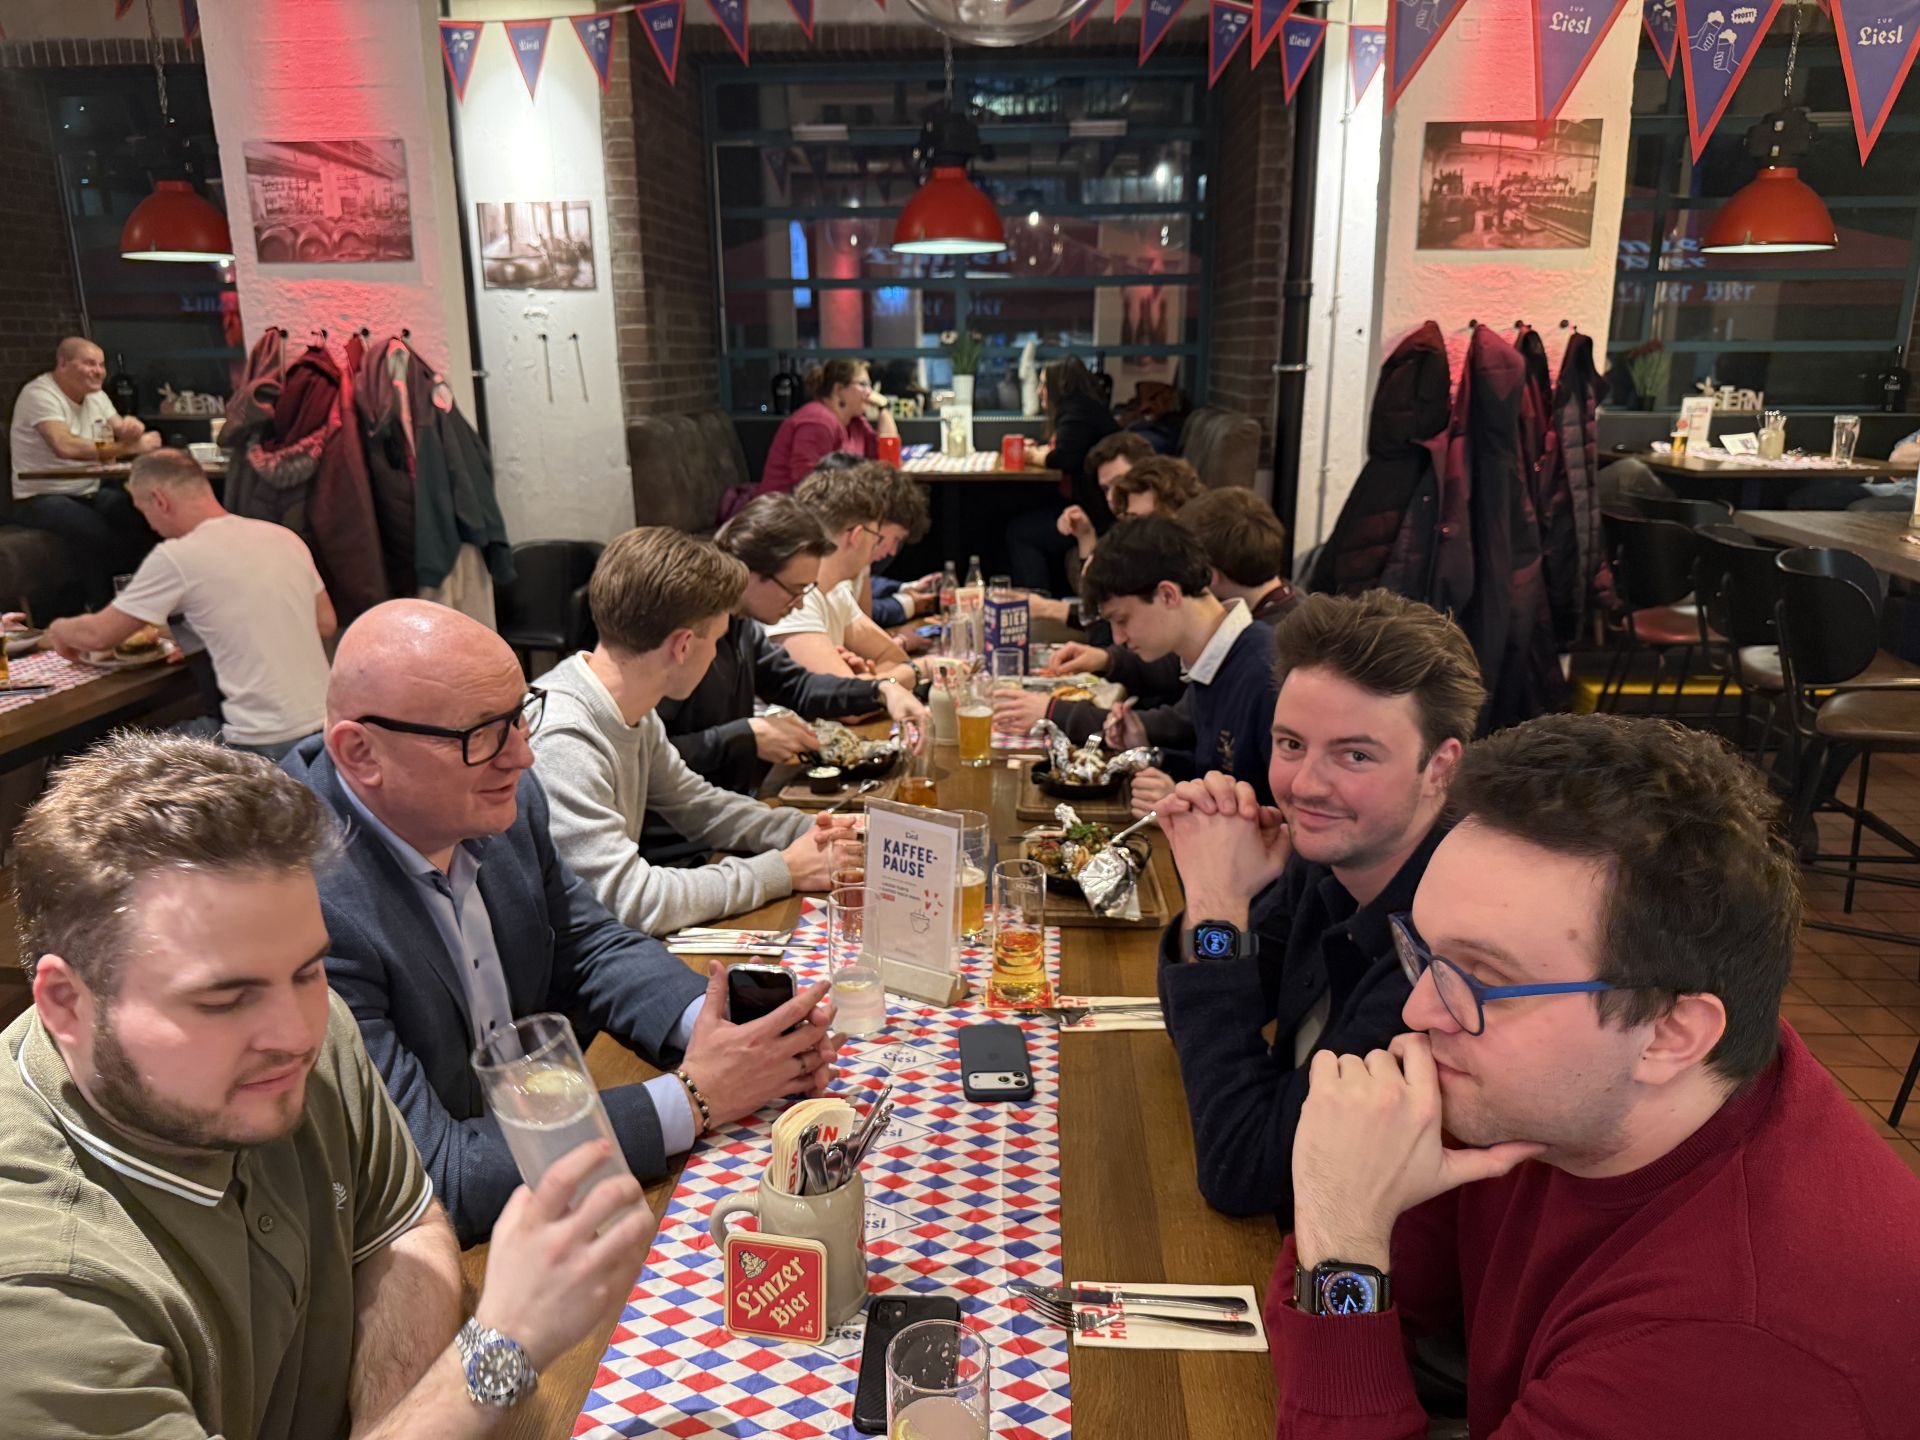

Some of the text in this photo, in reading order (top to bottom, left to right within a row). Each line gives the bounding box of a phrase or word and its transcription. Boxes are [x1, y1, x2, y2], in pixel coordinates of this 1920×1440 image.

[1549, 11, 1592, 35] Liesl
[1857, 25, 1903, 46] Liesl
[1000, 611, 1027, 628] BIER
[883, 837, 938, 864] KAFFEE-
[883, 854, 925, 879] PAUSE
[882, 1051, 917, 1063] Liesl
[736, 1255, 805, 1319] Linzer
[769, 1290, 810, 1328] Bier
